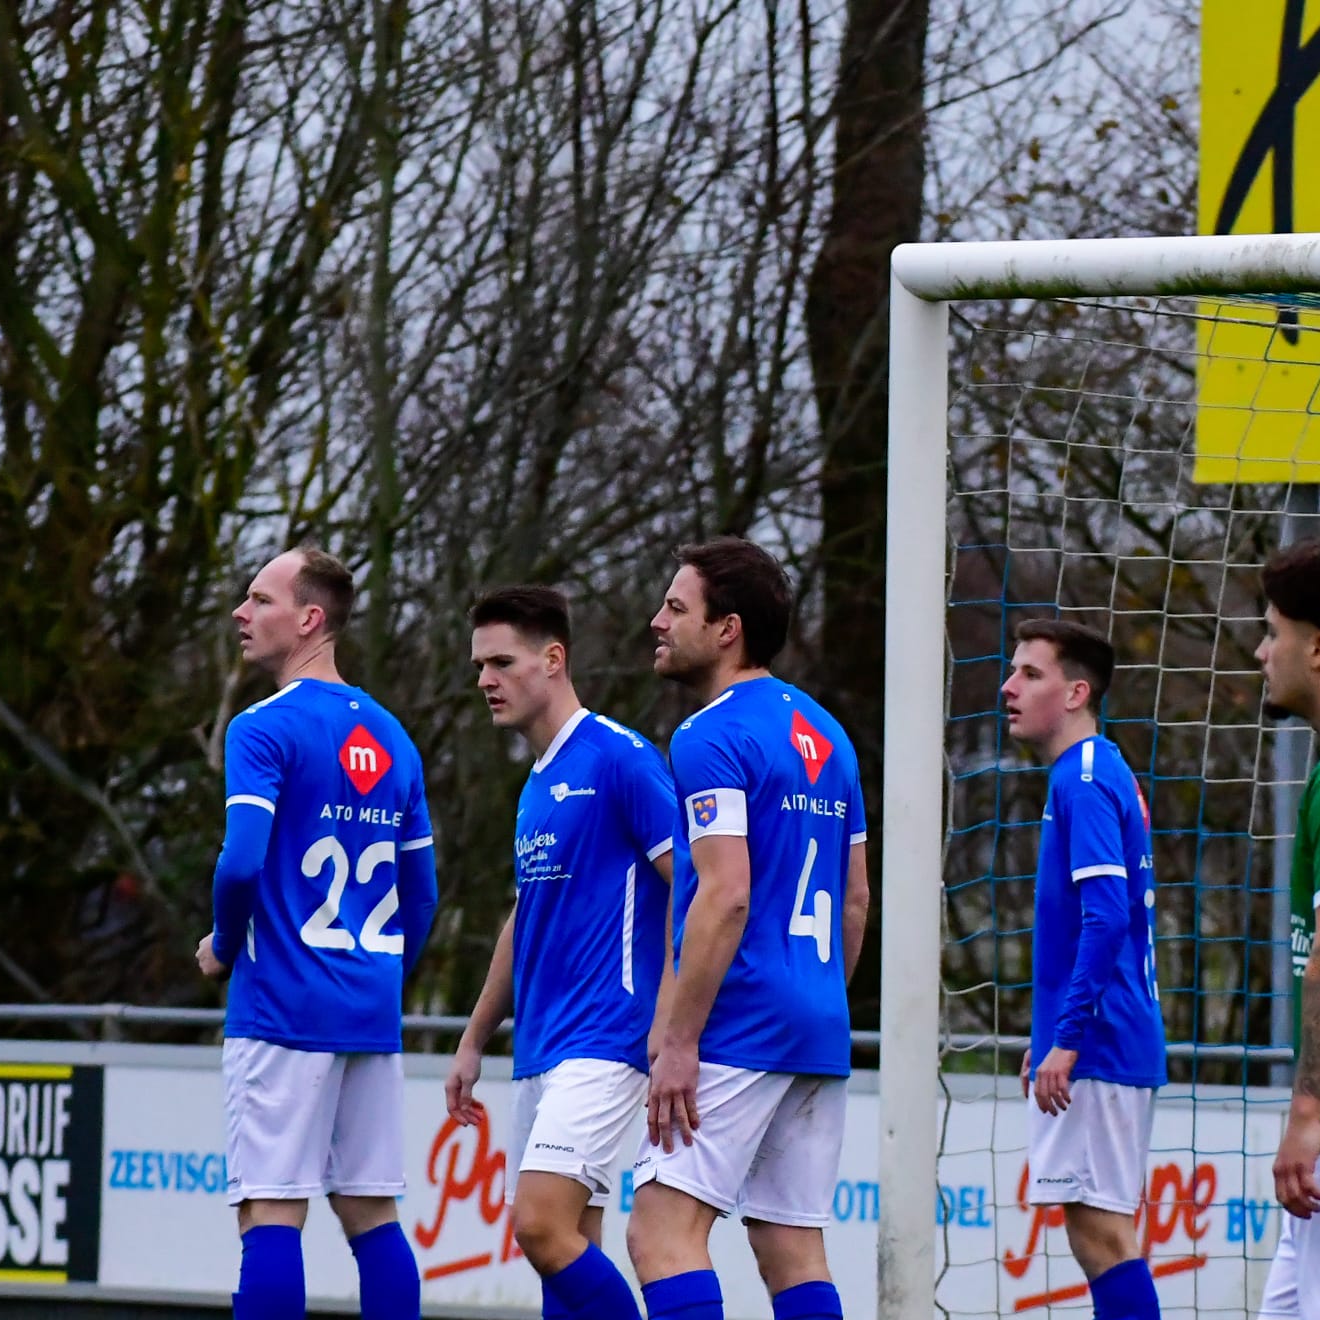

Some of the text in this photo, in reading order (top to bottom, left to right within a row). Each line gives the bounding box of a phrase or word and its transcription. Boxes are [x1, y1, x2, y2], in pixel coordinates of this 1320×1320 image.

[300, 835, 405, 955] 22
[789, 837, 832, 964] 4
[109, 1151, 228, 1193] ZEEVISG
[1227, 1198, 1270, 1244] BV
